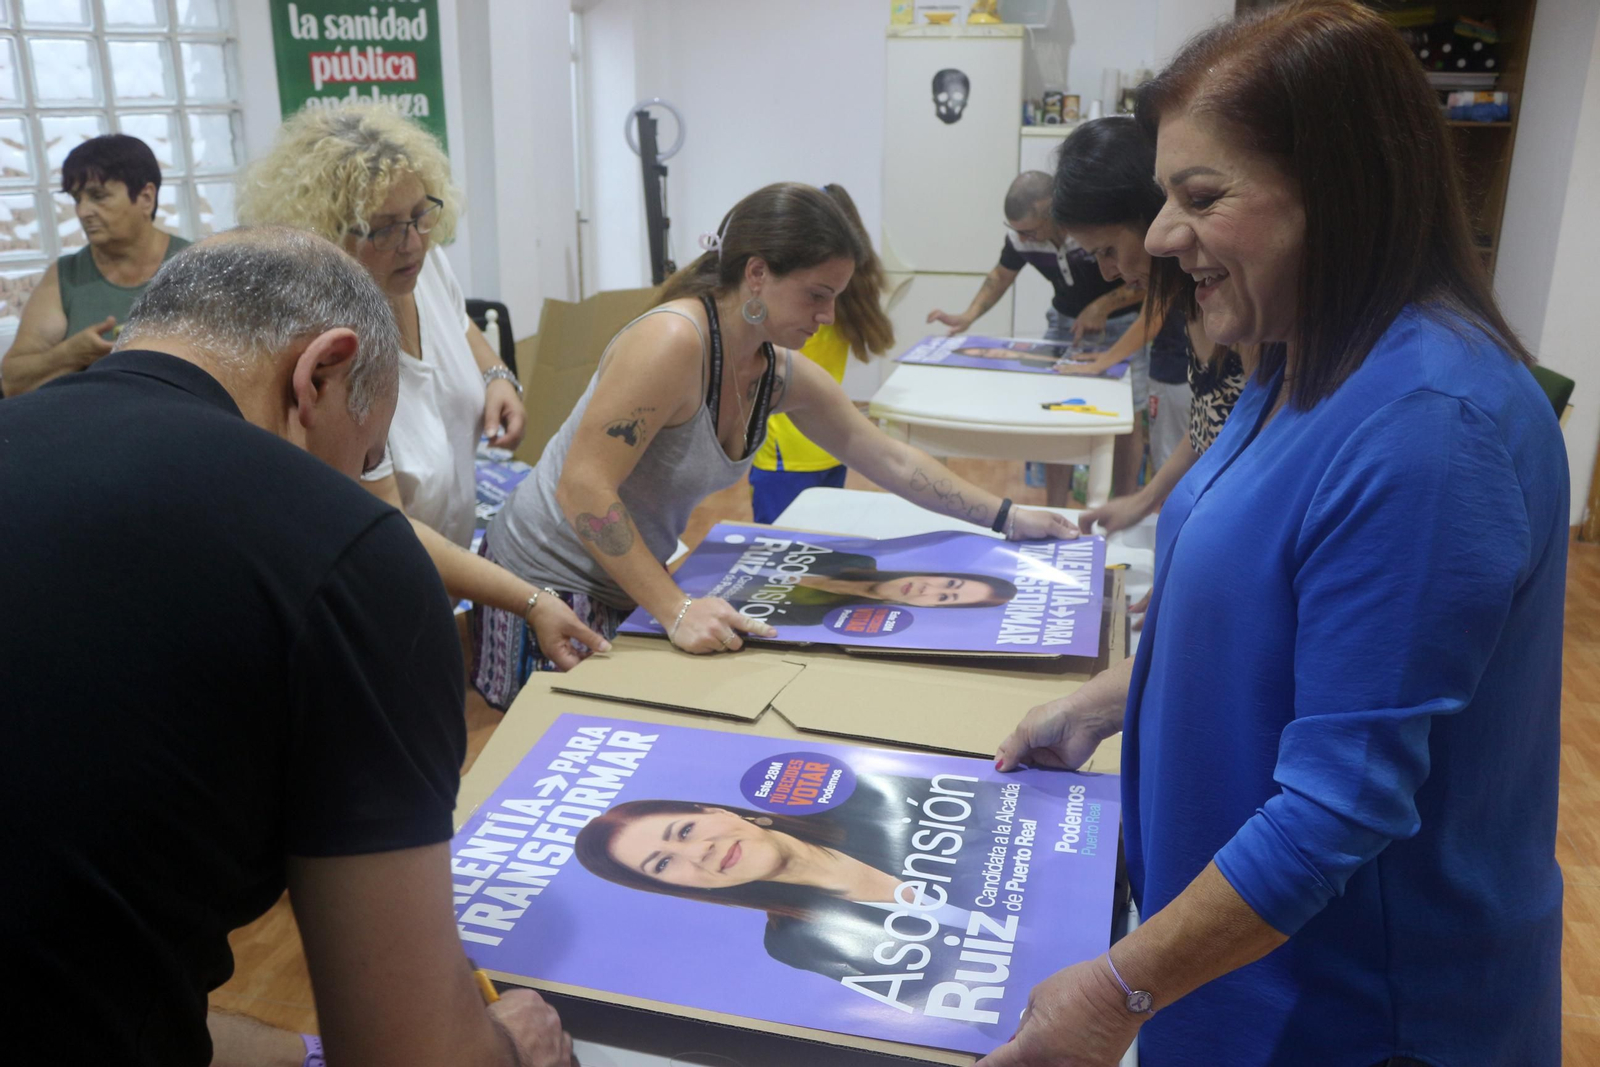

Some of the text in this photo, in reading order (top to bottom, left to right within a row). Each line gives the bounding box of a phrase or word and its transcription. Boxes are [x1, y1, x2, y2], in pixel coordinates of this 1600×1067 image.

[288, 3, 428, 41] la sanidad
[311, 45, 416, 91] pública
[1041, 618, 1075, 646] PARA
[754, 762, 783, 798] Este 28M
[777, 759, 805, 793] DECIDES
[787, 762, 830, 805] VOTAR
[817, 769, 842, 804] Podemos
[451, 727, 612, 915] LENTÍA PARA
[457, 730, 659, 946] TRANSFORMAR
[975, 783, 1020, 908] Candidata a la Alcaldía
[1054, 785, 1086, 853] Podemos
[1081, 803, 1101, 856] Puerto Real
[1002, 819, 1037, 911] de Puerto Real
[840, 773, 979, 1014] Ascensión
[923, 910, 1019, 1025] Ruiz
